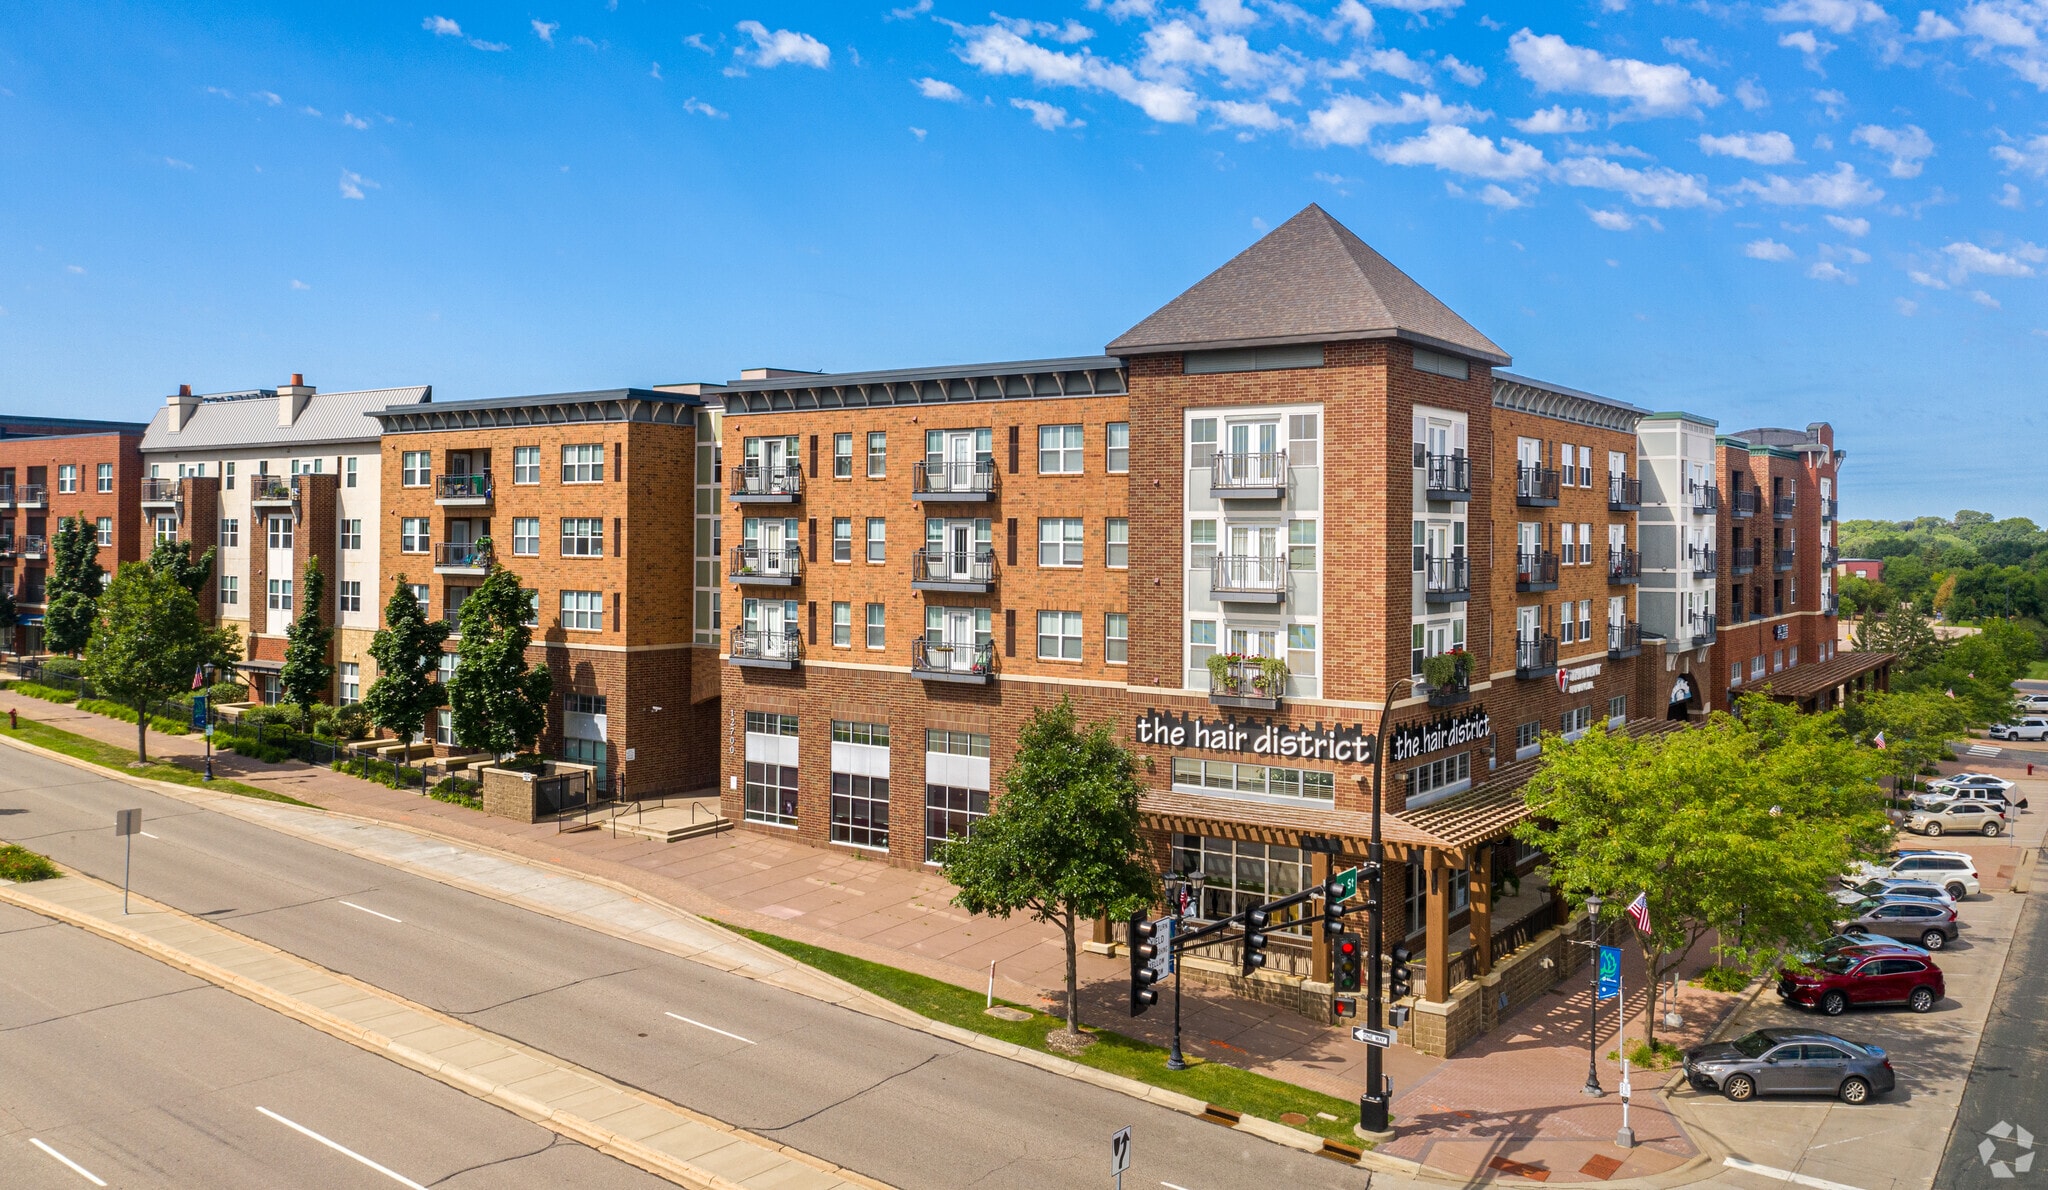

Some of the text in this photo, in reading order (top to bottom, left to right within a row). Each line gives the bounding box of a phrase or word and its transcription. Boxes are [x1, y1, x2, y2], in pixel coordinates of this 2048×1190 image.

[1137, 716, 1370, 762] the hair district
[1395, 713, 1490, 760] the hair district
[1347, 877, 1354, 889] St
[1363, 1033, 1386, 1043] ONE WAY
